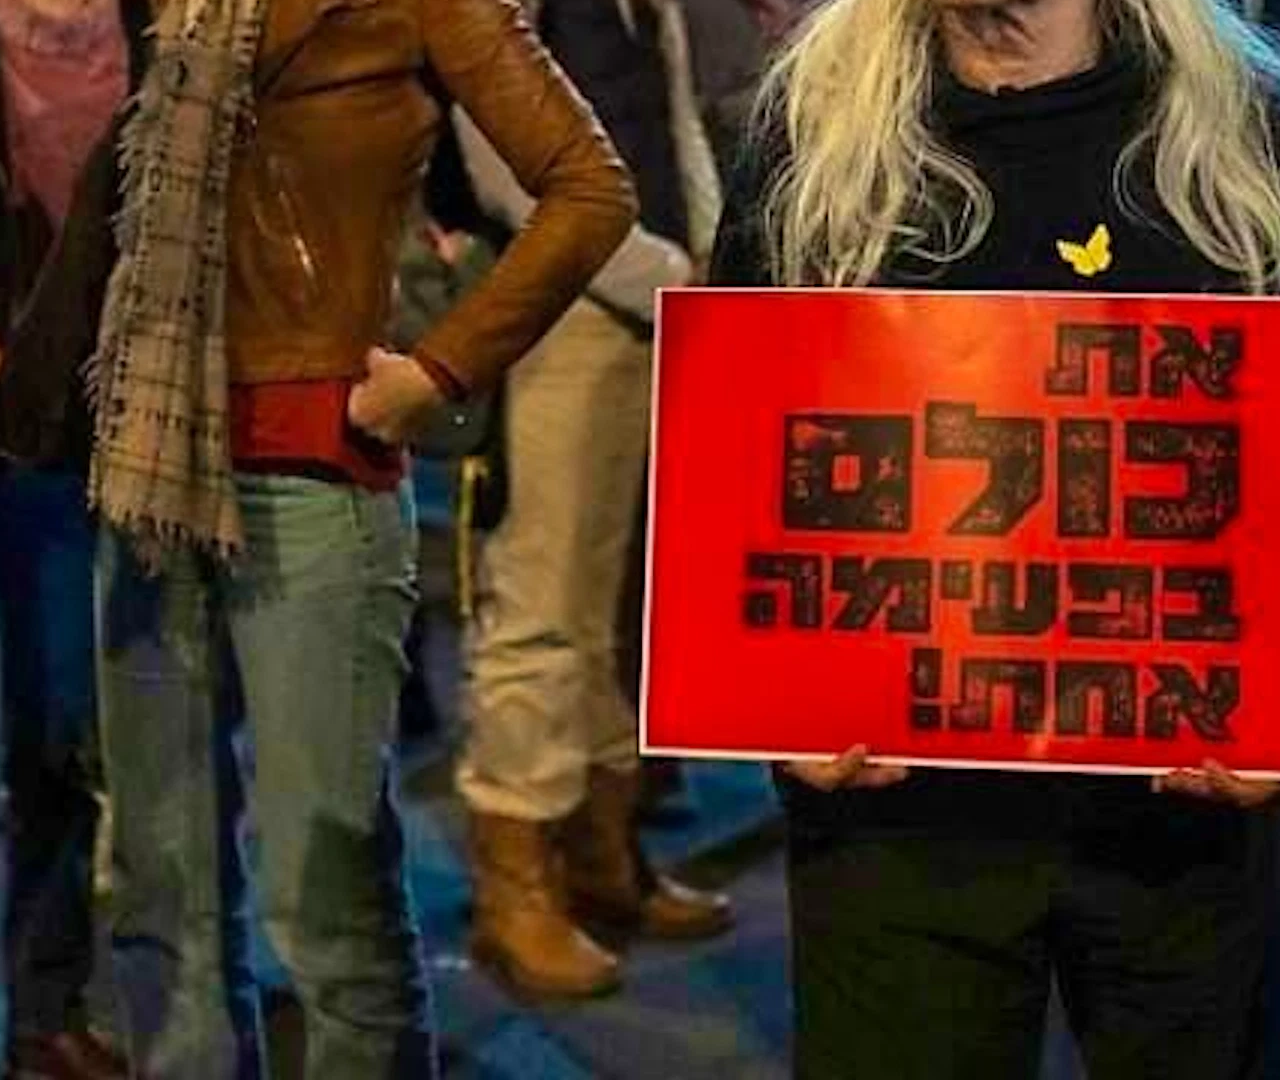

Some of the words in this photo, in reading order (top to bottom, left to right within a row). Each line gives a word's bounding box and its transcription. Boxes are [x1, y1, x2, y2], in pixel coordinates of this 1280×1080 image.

[1046, 322, 1244, 399] את
[783, 402, 1241, 542] כולם
[742, 552, 1242, 643] בפעימה
[908, 648, 1241, 743] אחת!
